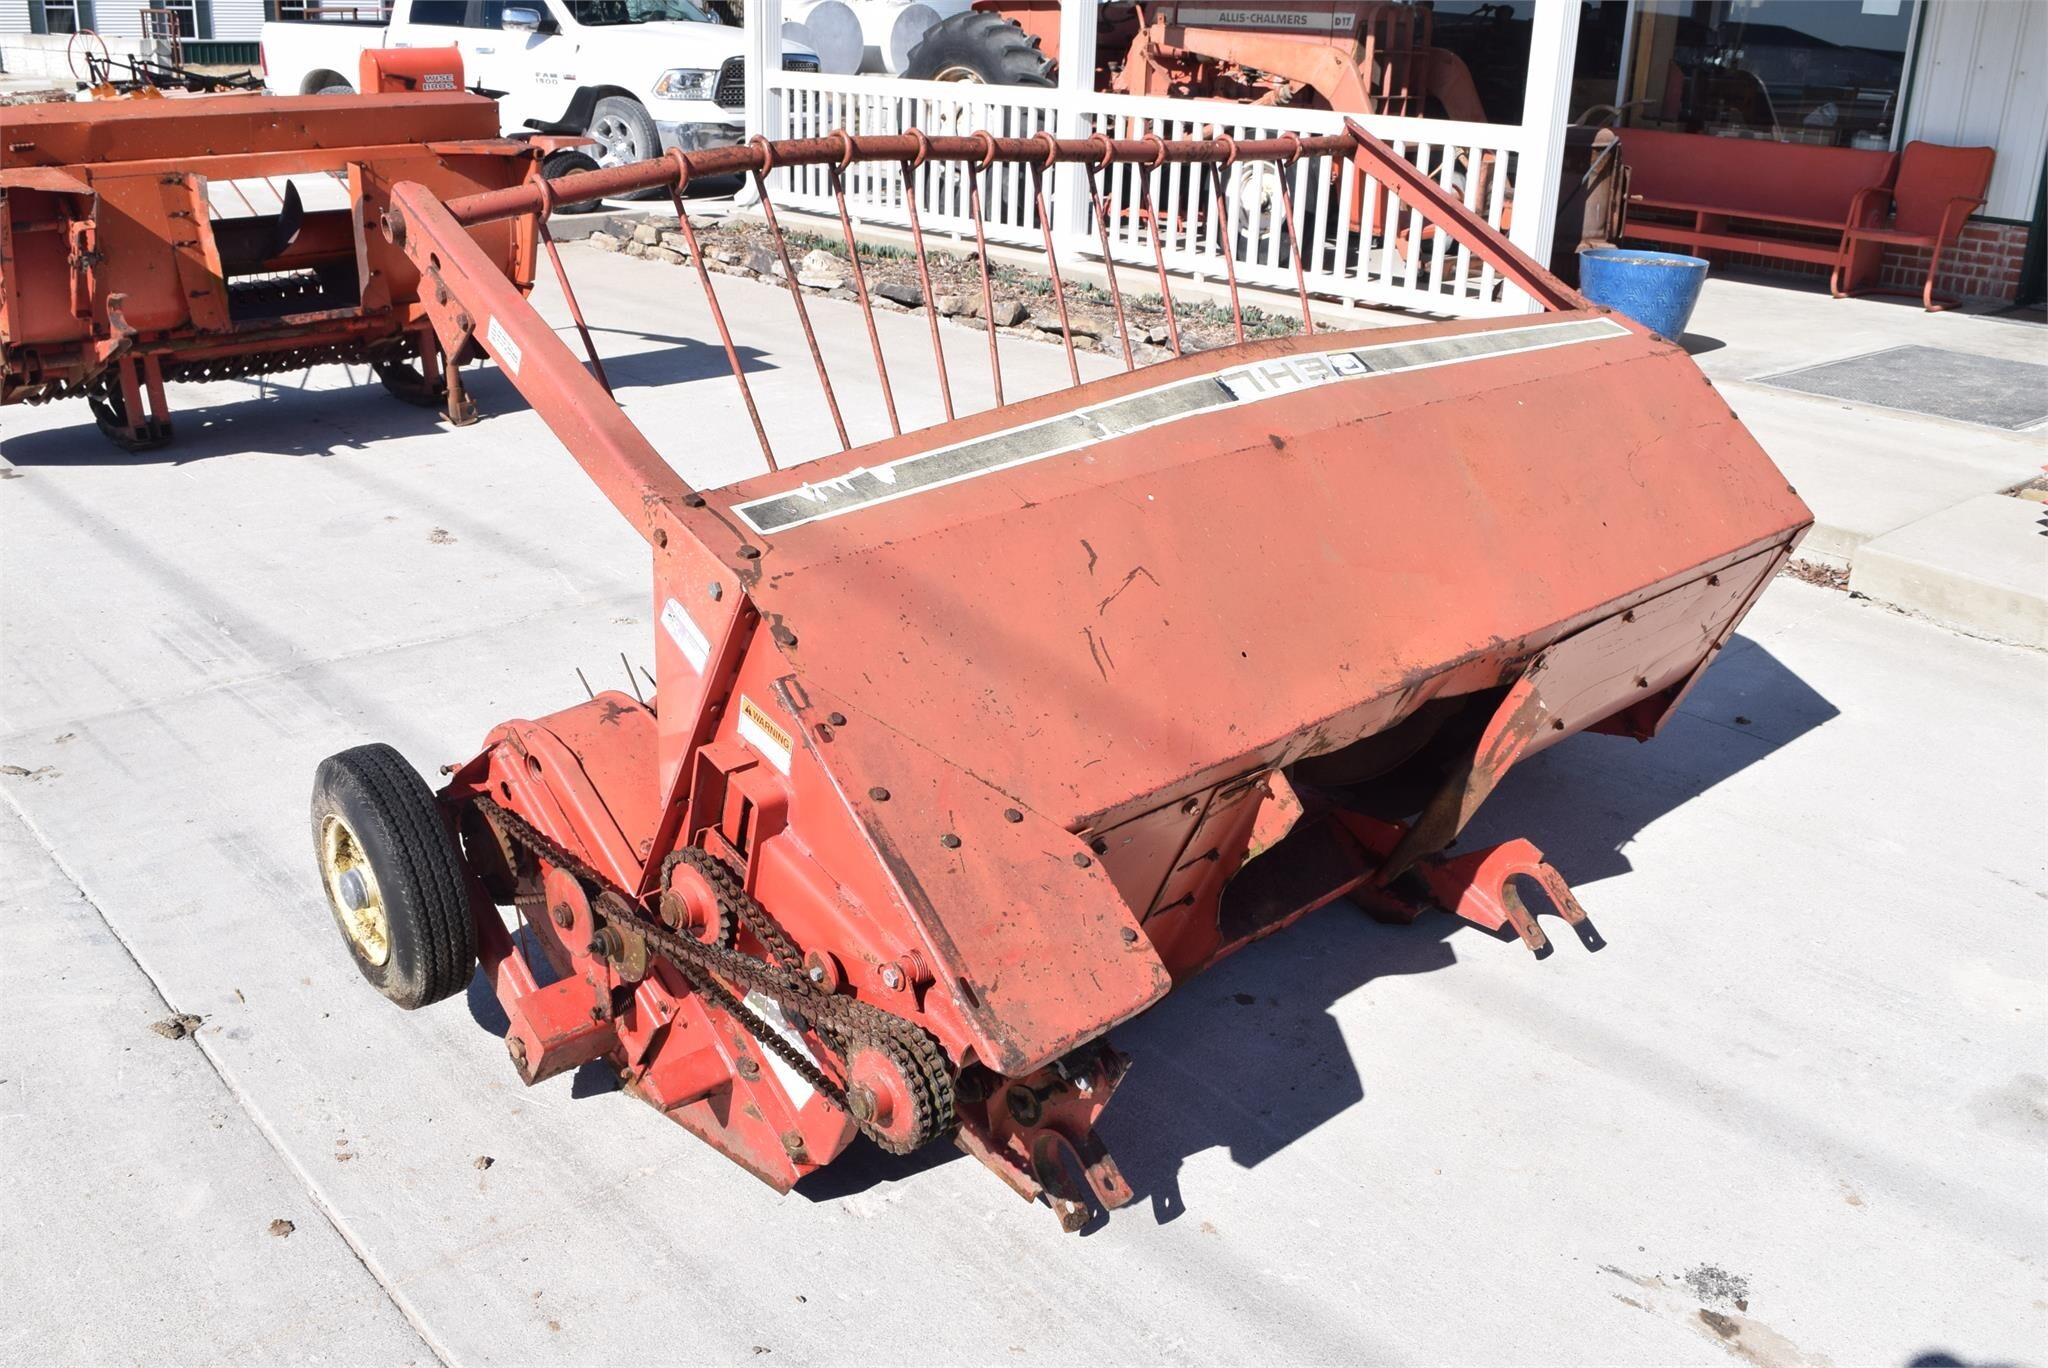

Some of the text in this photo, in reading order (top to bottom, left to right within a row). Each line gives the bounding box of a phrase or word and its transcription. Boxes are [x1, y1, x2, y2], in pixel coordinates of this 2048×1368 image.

[1218, 12, 1308, 25] ALLIS-CHALMERS
[423, 73, 454, 83] WISE
[752, 711, 790, 749] WARNING
